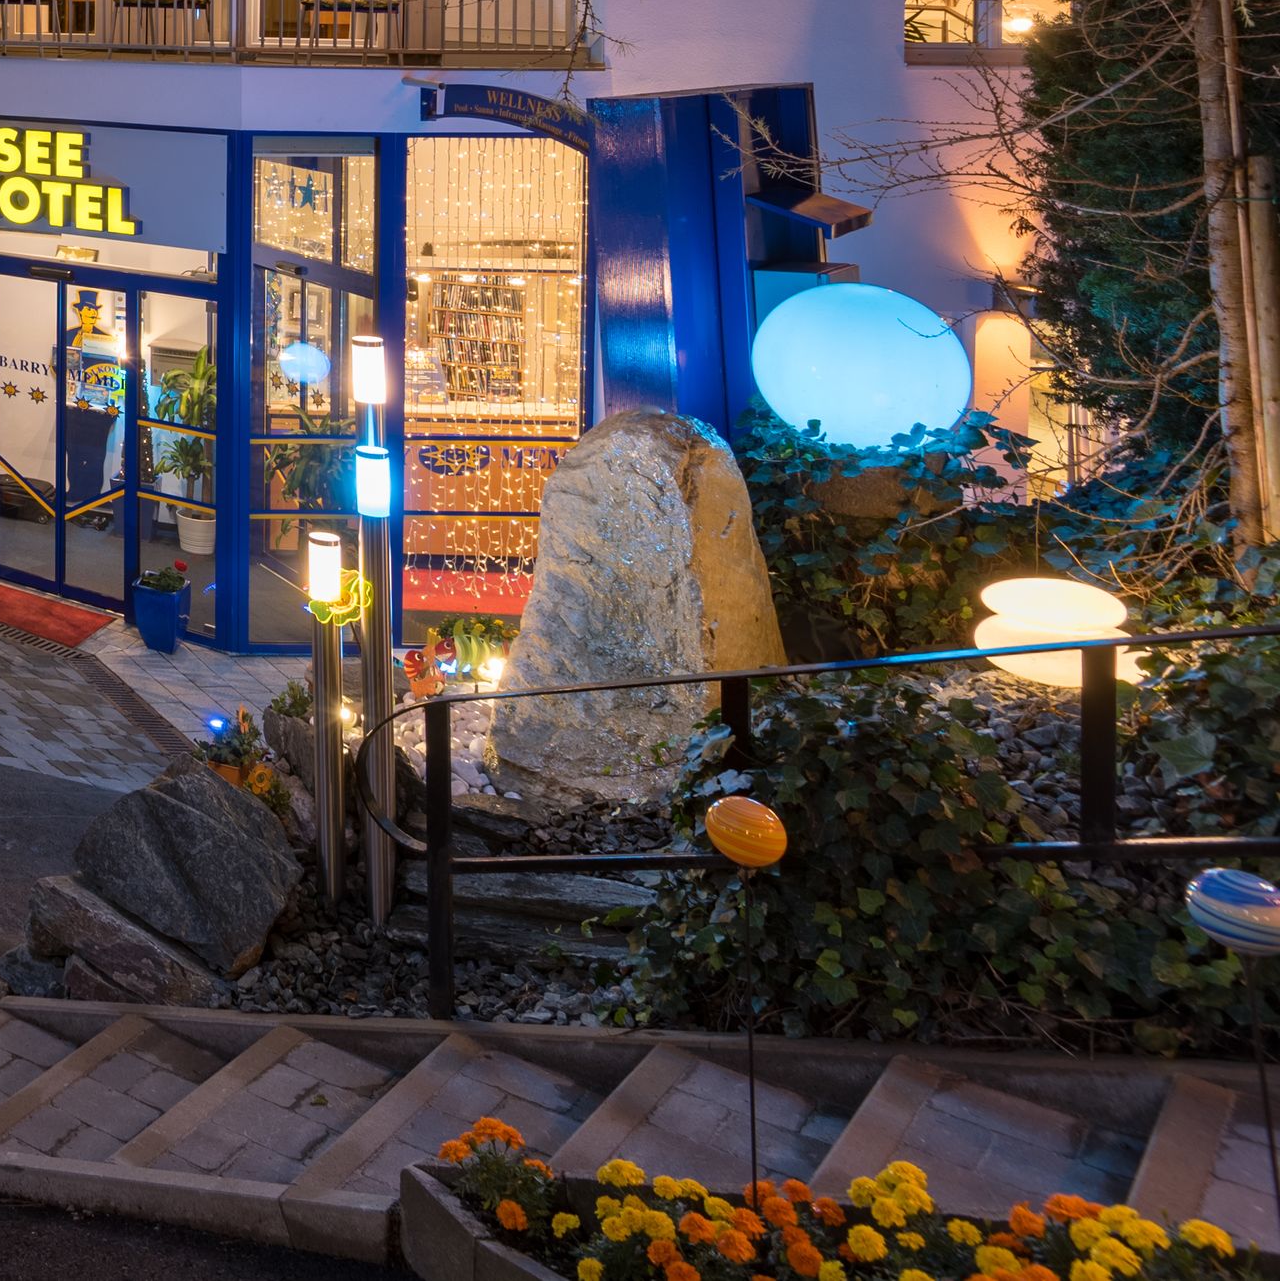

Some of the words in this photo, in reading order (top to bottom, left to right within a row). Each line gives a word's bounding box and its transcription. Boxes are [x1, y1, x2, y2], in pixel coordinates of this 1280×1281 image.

[487, 90, 561, 122] WELLNESS
[0, 355, 51, 387] BARRY
[501, 447, 568, 469] MEM
